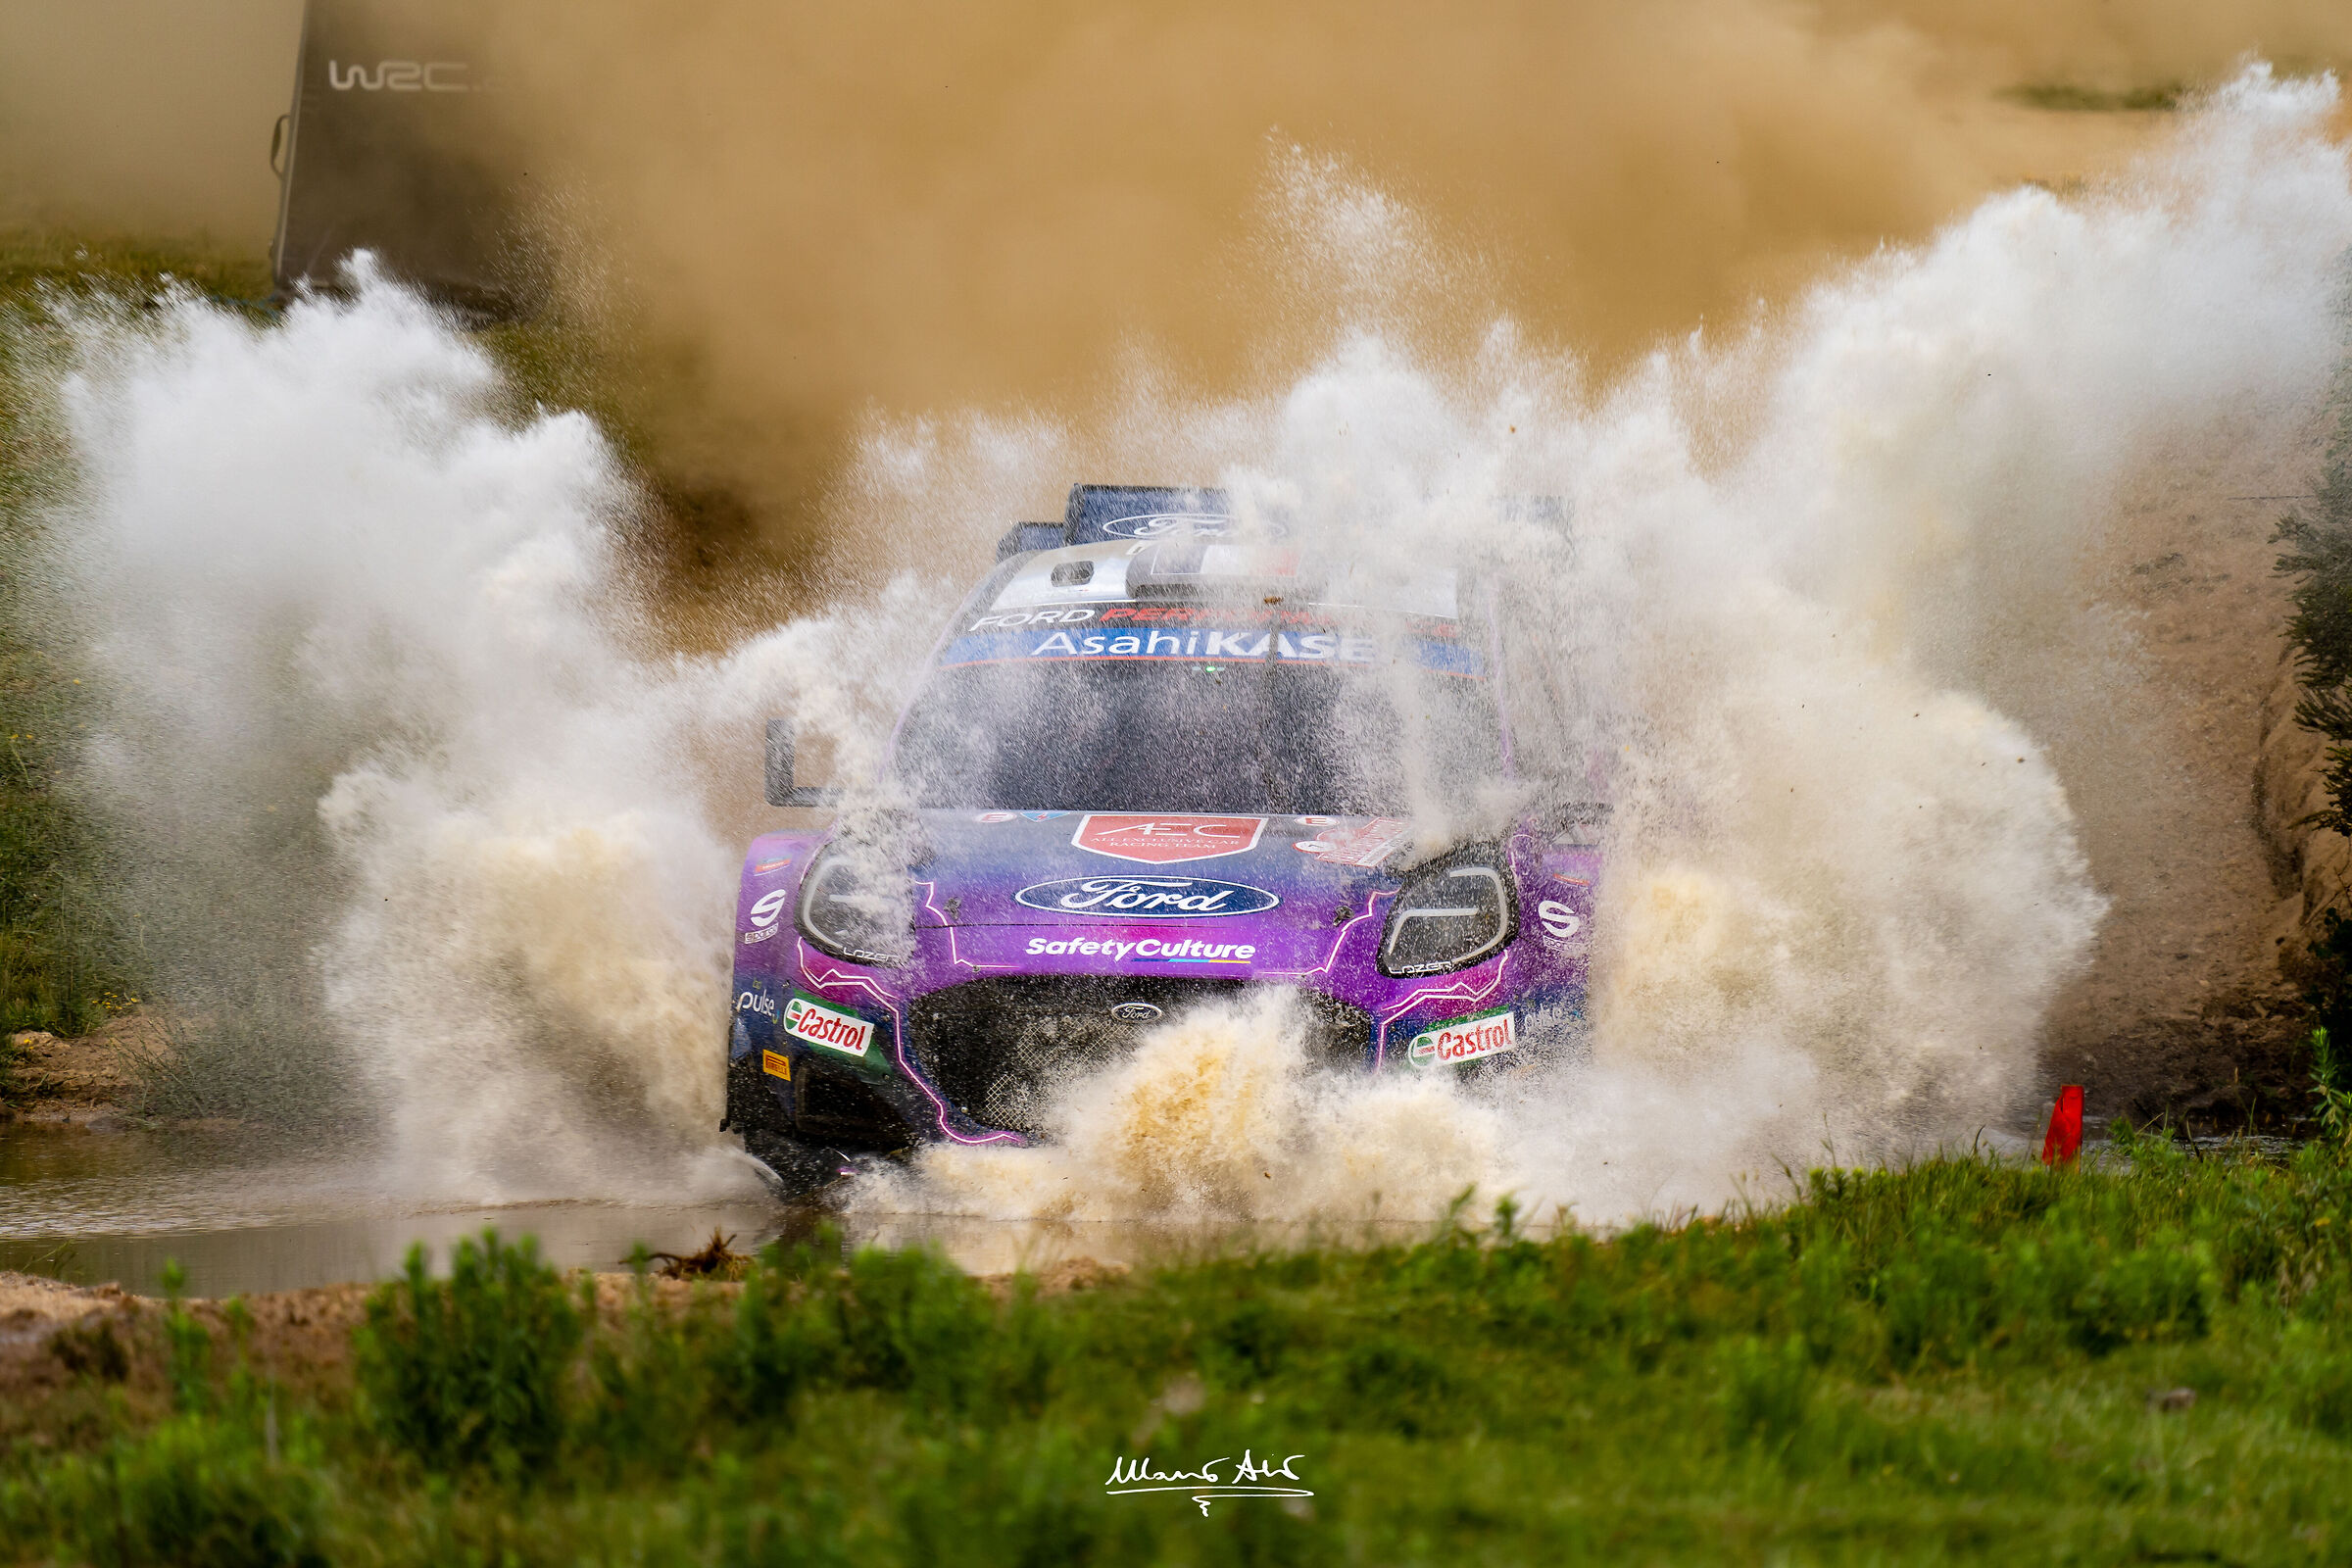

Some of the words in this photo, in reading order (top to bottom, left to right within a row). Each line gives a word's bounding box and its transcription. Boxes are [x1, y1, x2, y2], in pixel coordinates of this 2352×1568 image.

[968, 609, 1096, 632] FORD
[1031, 630, 1376, 662] AsahiKASE
[1060, 879, 1234, 911] Ford
[1026, 937, 1256, 962] SafetyCulture
[736, 989, 774, 1017] pulse
[798, 1008, 866, 1051] Castrol
[1437, 1018, 1512, 1060] Castrol
